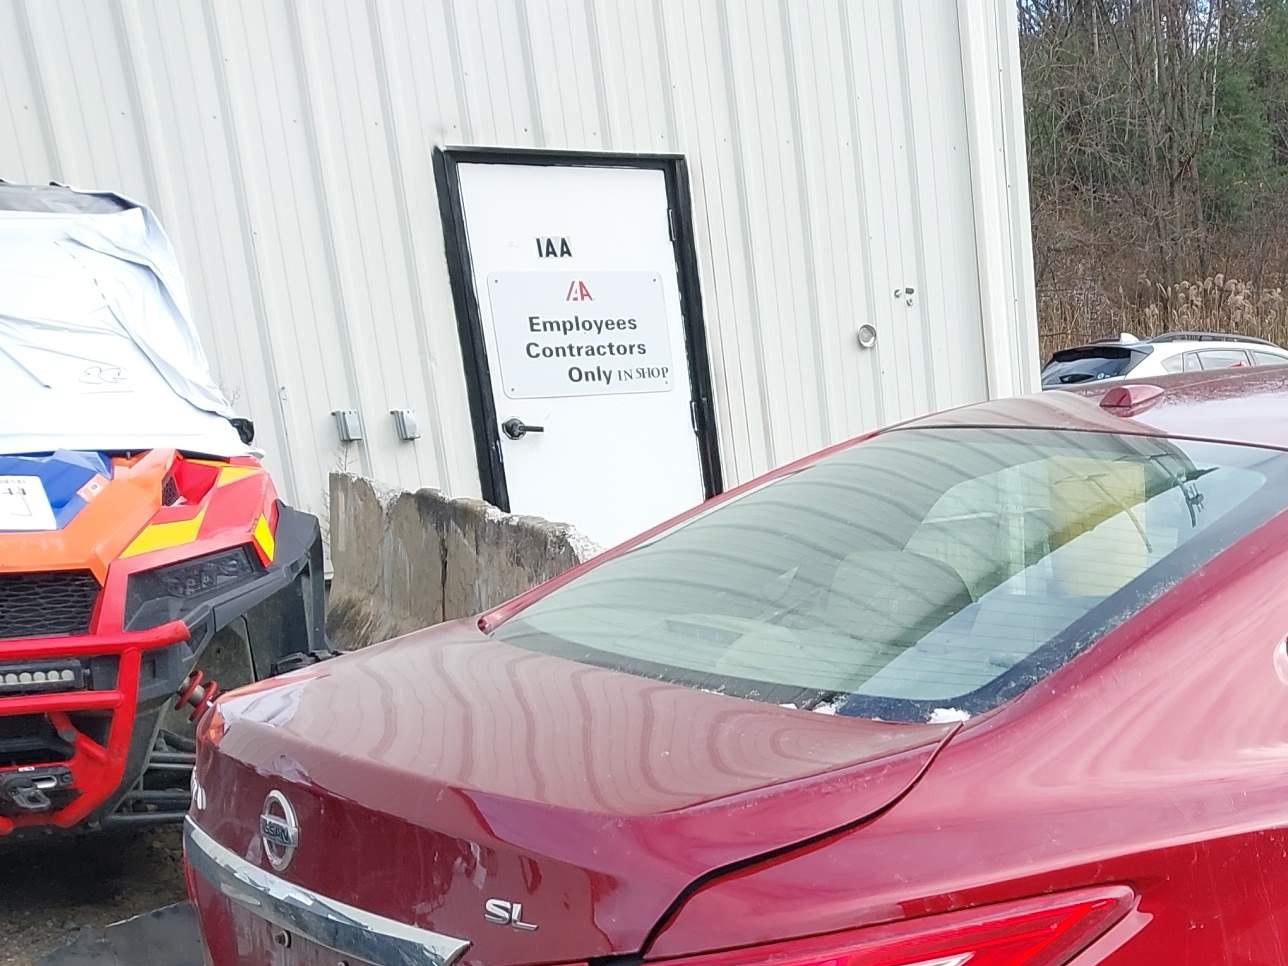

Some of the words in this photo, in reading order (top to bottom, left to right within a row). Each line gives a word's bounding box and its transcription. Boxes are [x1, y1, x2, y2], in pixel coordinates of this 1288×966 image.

[535, 237, 573, 258] IAA
[528, 315, 638, 335] Employees
[526, 341, 647, 358] Contractors
[568, 366, 613, 385] Only
[617, 369, 633, 381] IN
[635, 367, 669, 379] SHOP
[484, 898, 539, 931] SL
